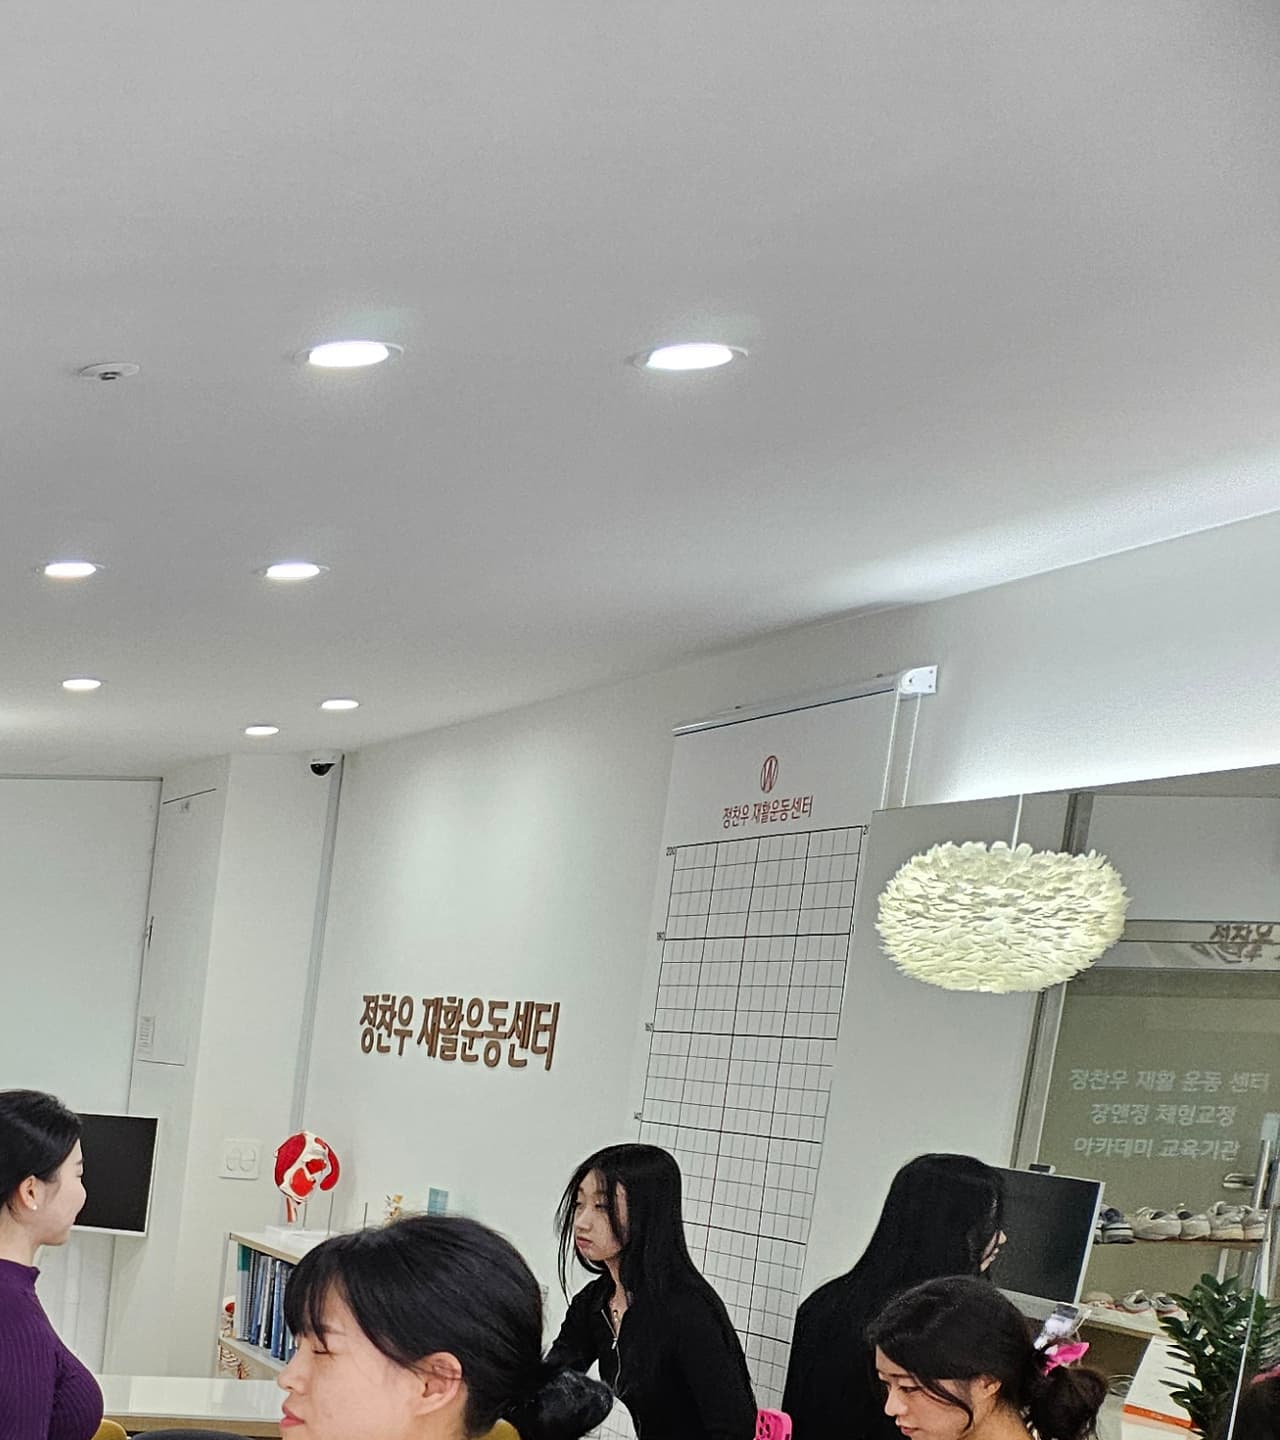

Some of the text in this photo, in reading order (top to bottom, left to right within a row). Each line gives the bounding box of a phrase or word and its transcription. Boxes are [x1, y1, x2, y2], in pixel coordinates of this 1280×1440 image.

[722, 795, 814, 829] 정찬우 재활운동센터
[359, 994, 560, 1071] 정찬우 재활운동센터
[1070, 1070, 1129, 1090] 정찬우
